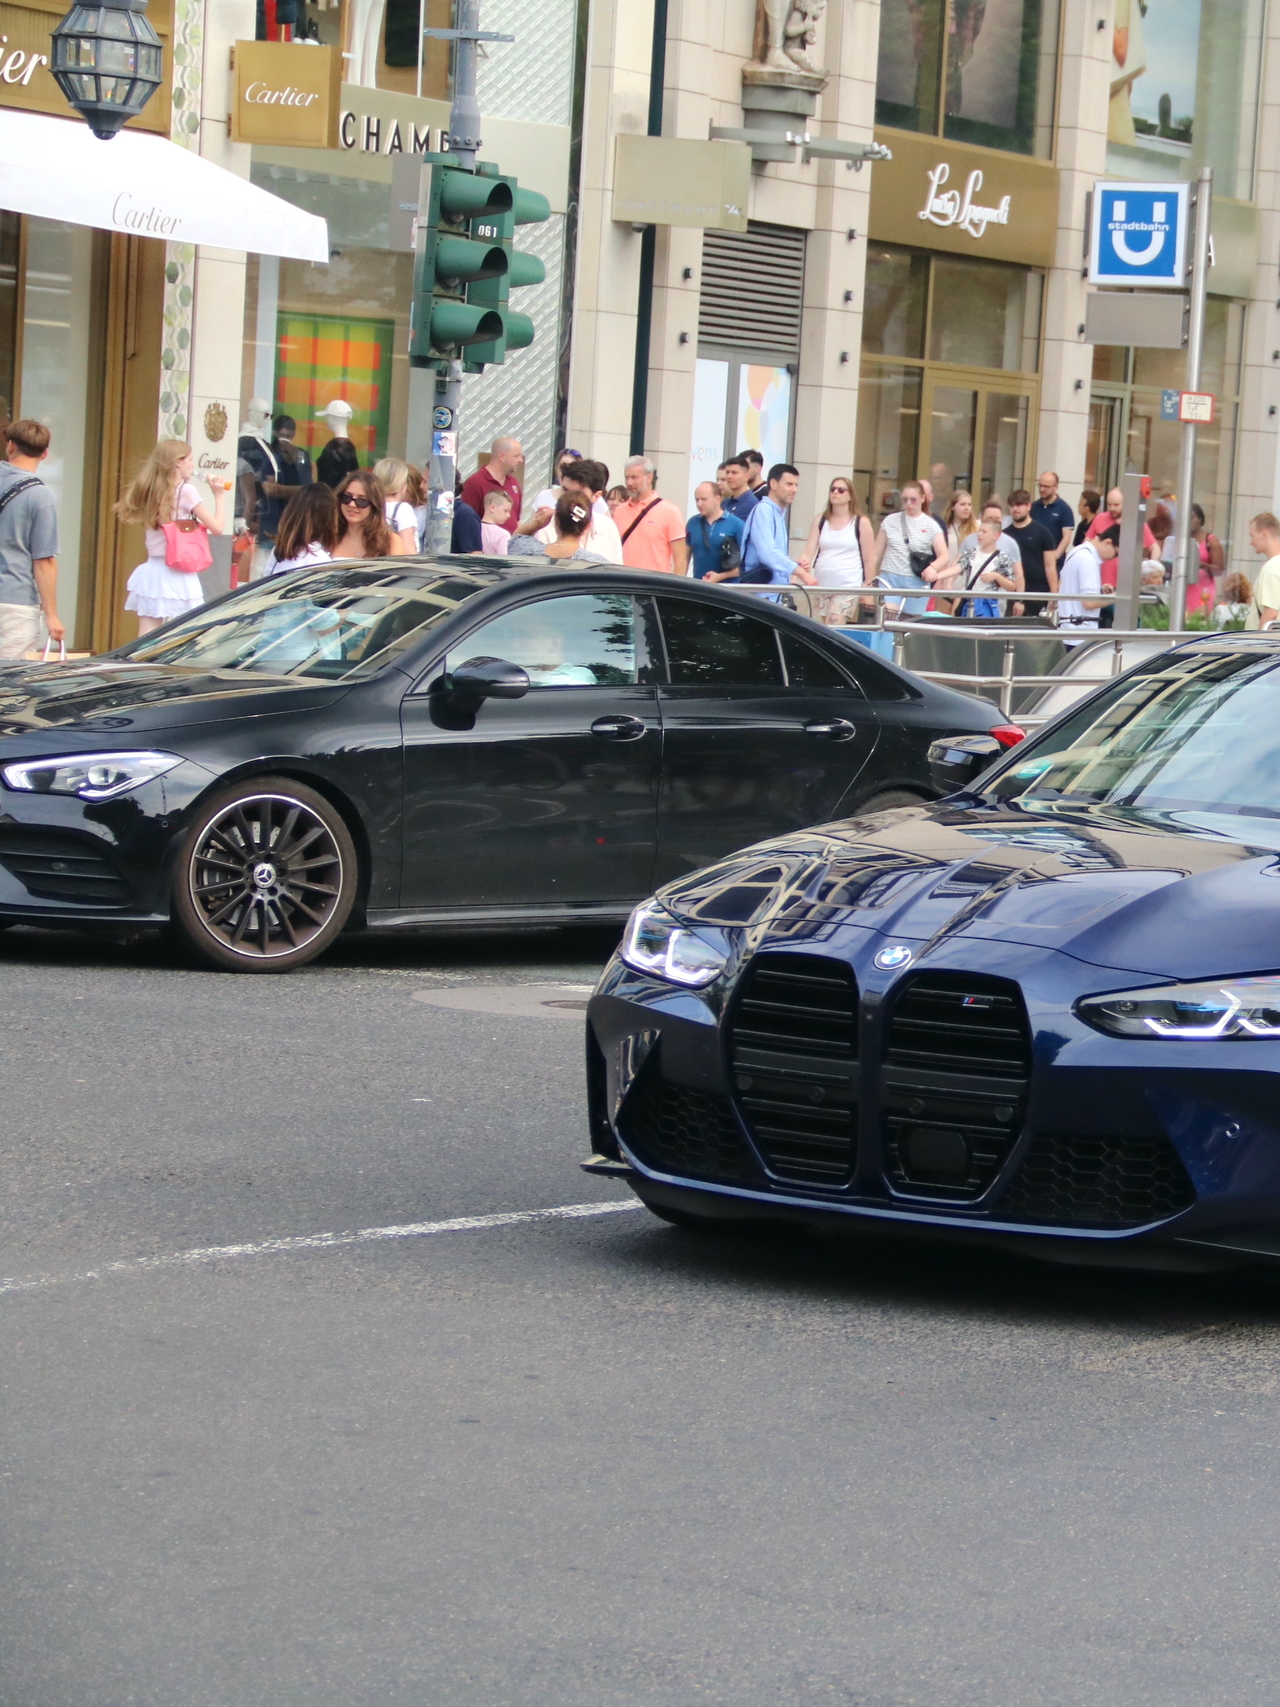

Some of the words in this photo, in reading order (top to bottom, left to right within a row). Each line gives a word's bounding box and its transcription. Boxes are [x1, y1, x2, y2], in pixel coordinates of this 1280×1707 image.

[245, 81, 319, 107] Cartier
[112, 191, 182, 235] Cartier
[478, 224, 498, 238] 061
[1107, 221, 1170, 232] stadtbahn
[198, 452, 230, 470] Cartier
